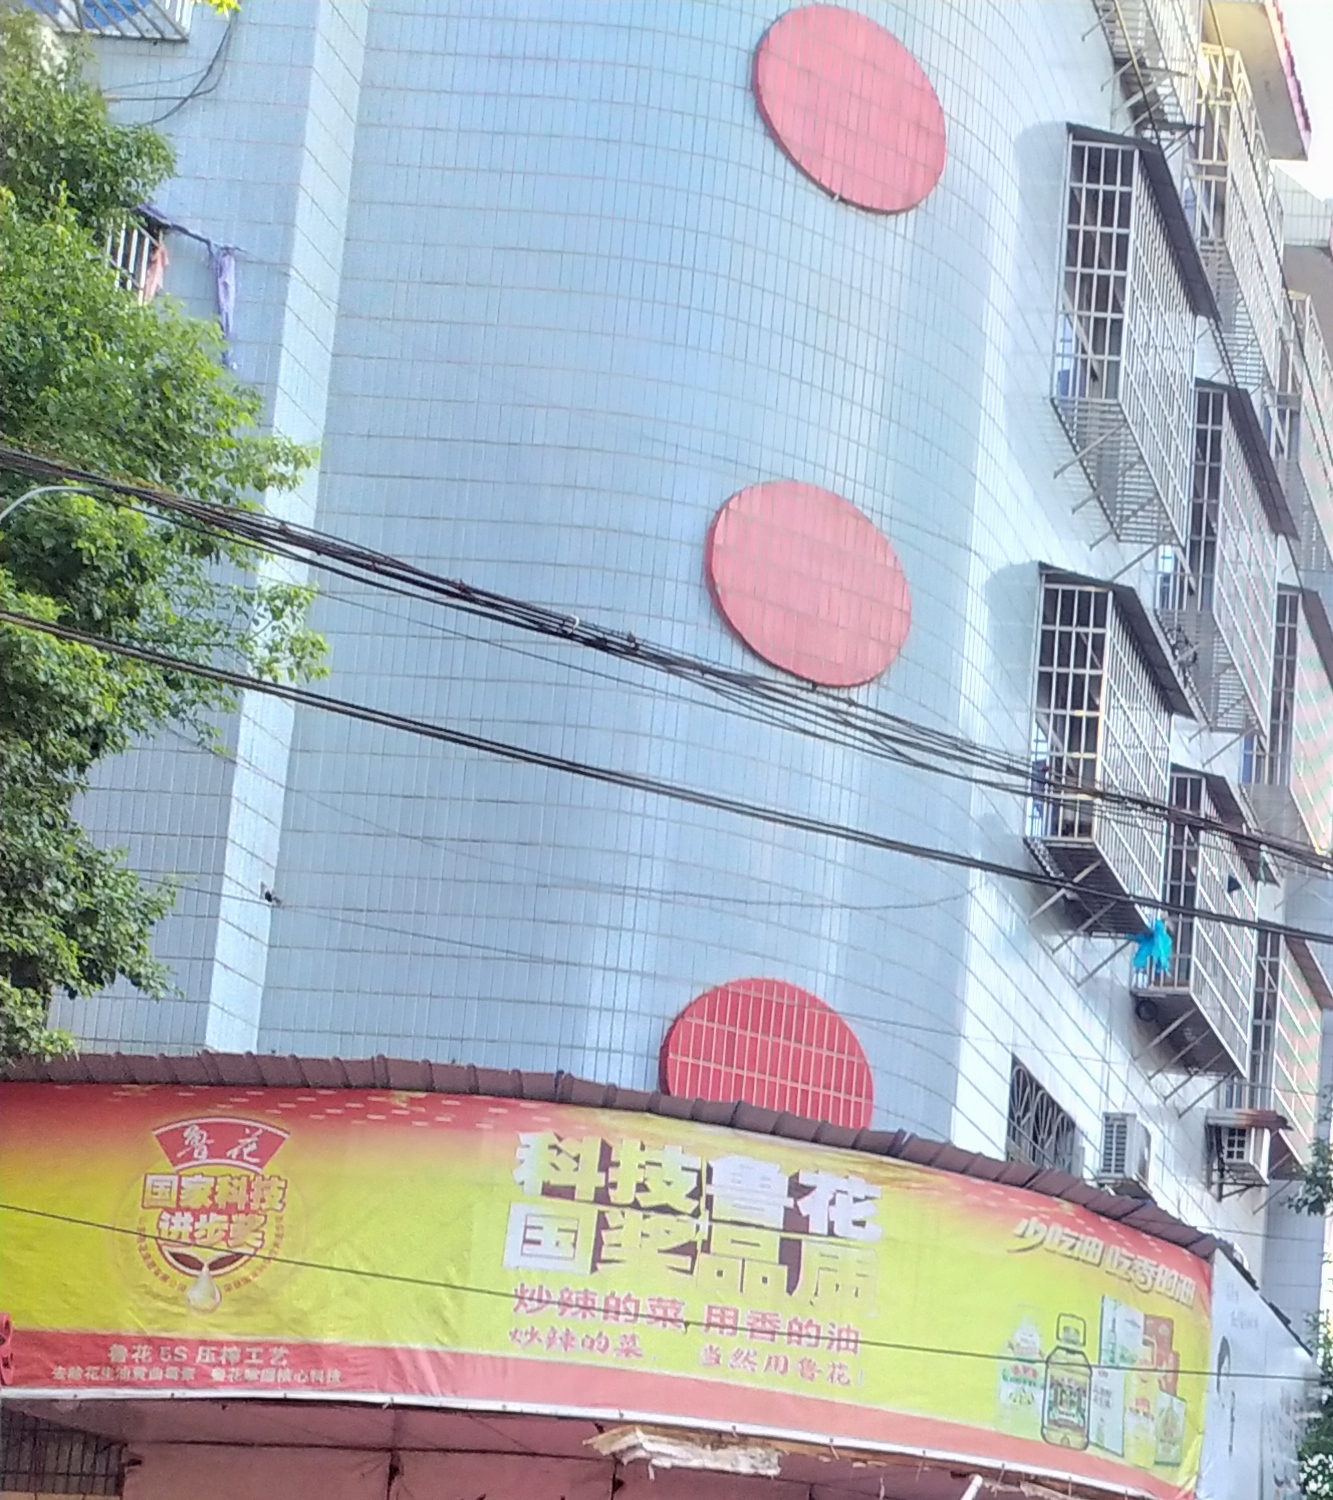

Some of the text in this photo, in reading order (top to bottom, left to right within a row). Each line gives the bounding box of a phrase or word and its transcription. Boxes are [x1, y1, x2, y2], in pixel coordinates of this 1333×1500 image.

[142, 1173, 288, 1212] 国家科技
[515, 1132, 882, 1241] 科技鲁花
[157, 1210, 268, 1249] 进步奖
[502, 1203, 878, 1300] 国奖品质
[1006, 1217, 1104, 1268] 少吃油
[512, 1282, 861, 1355] 炒辣的菜 用香的油
[108, 1343, 290, 1367] 鲁花 5S 压榨工艺
